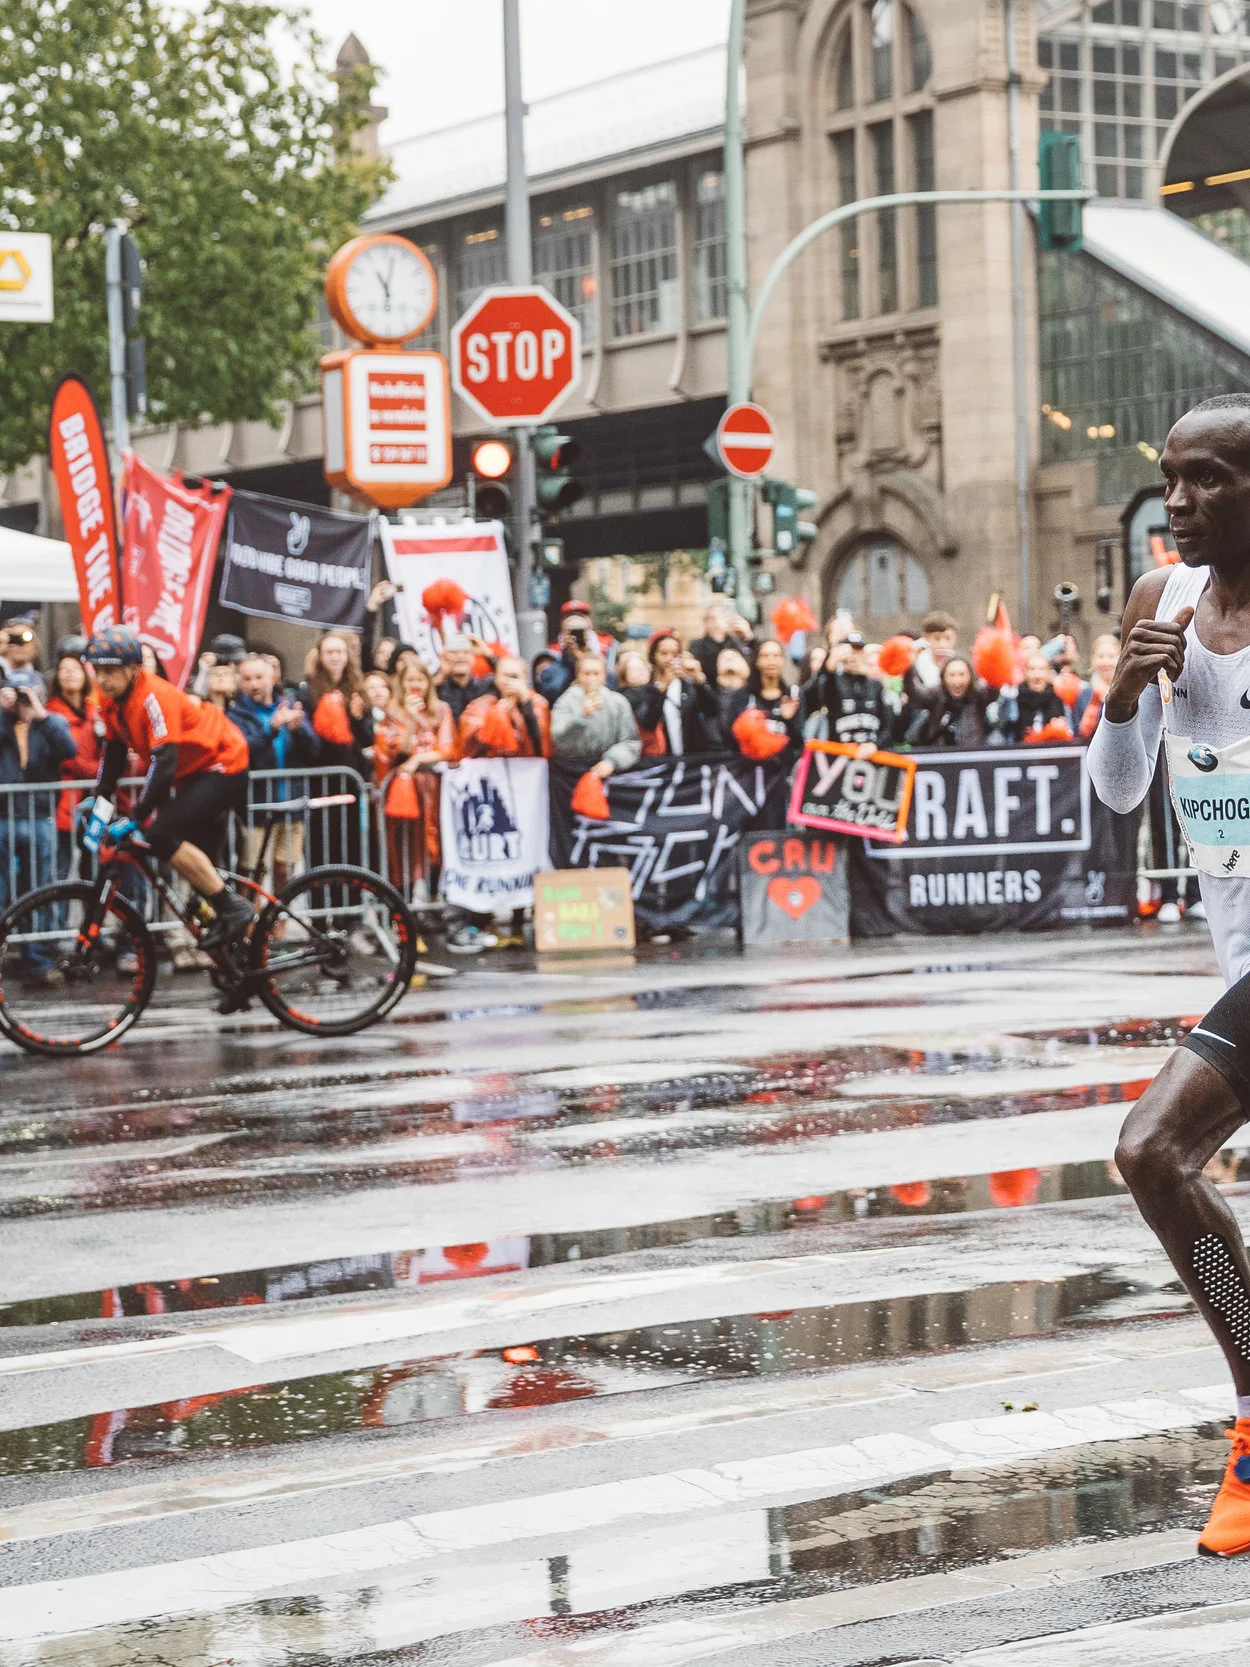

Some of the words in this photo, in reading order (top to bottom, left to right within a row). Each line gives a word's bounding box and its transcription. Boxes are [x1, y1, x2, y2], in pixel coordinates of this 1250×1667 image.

[466, 328, 566, 383] STOP
[59, 412, 105, 541] BRIDGE
[84, 532, 113, 611] THE
[811, 750, 905, 812] YOU
[914, 764, 1076, 841] RAFT.
[748, 838, 836, 875] CRU
[1218, 829, 1225, 839] 2
[1222, 849, 1241, 872] here
[908, 869, 1042, 906] RUNNERS
